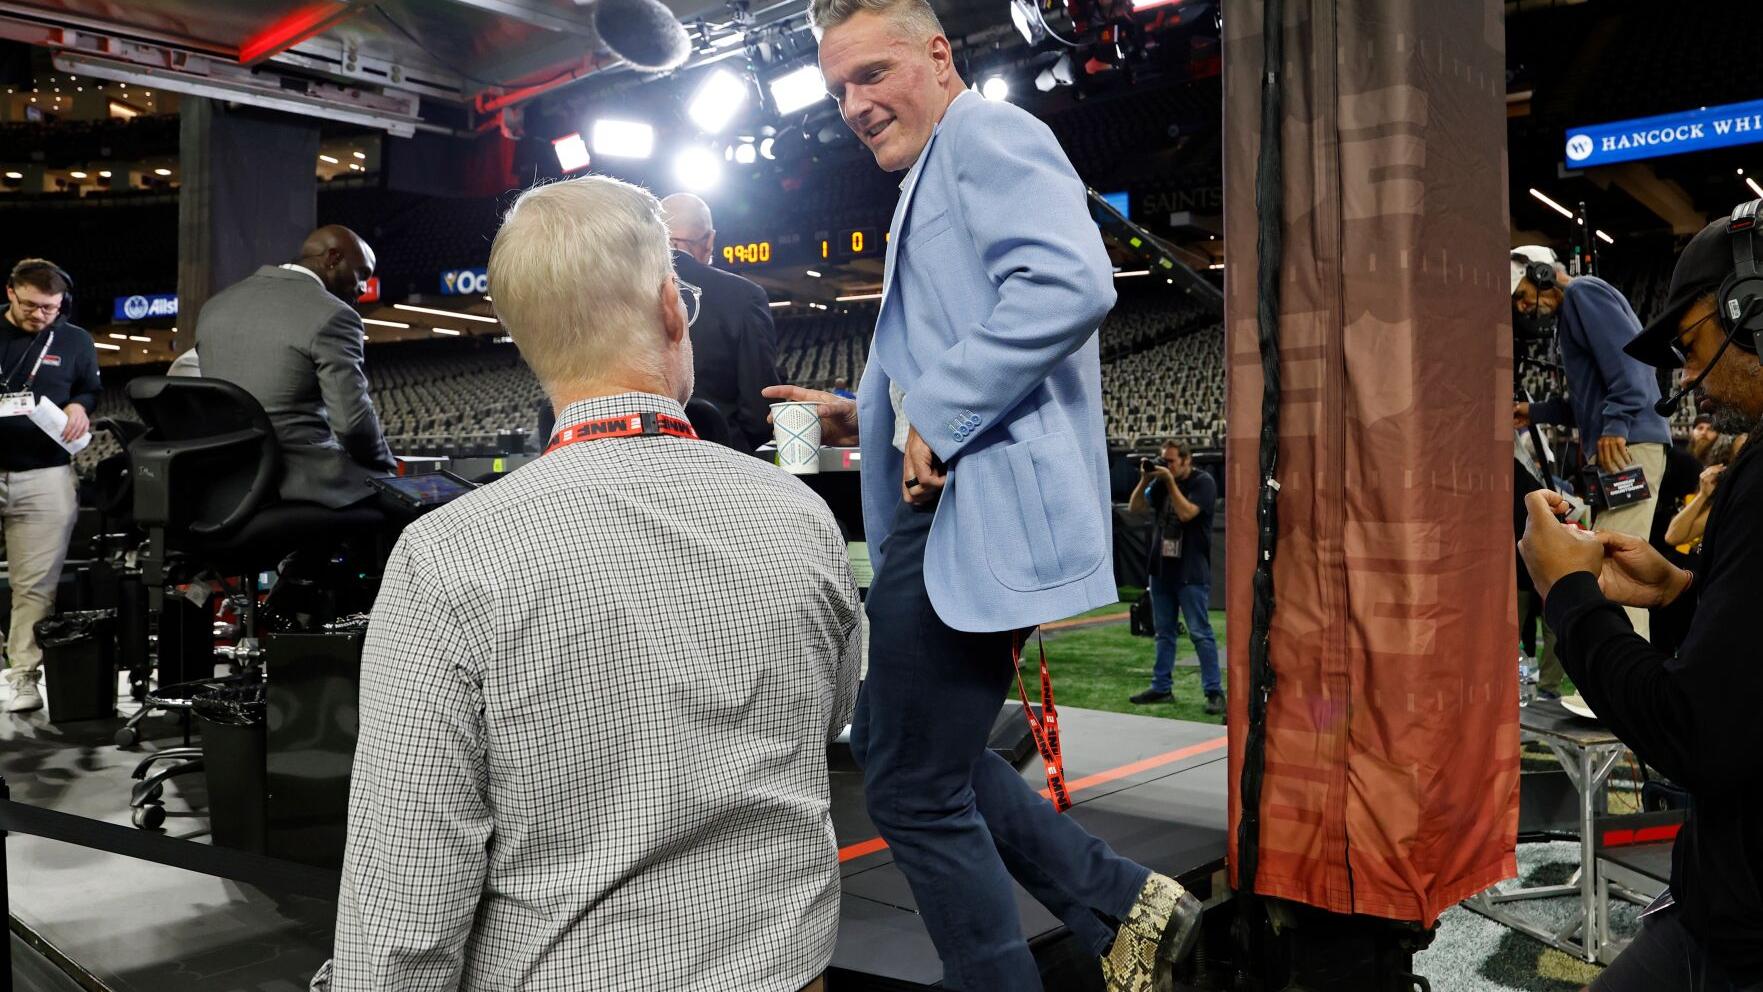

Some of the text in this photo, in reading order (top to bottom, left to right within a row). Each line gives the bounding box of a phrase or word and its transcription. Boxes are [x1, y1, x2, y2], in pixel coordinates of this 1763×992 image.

[1602, 123, 1704, 151] HANCOCK
[1713, 115, 1762, 136] WHI
[852, 231, 863, 252] 0
[723, 242, 770, 264] 99:00
[577, 418, 627, 438] MNF
